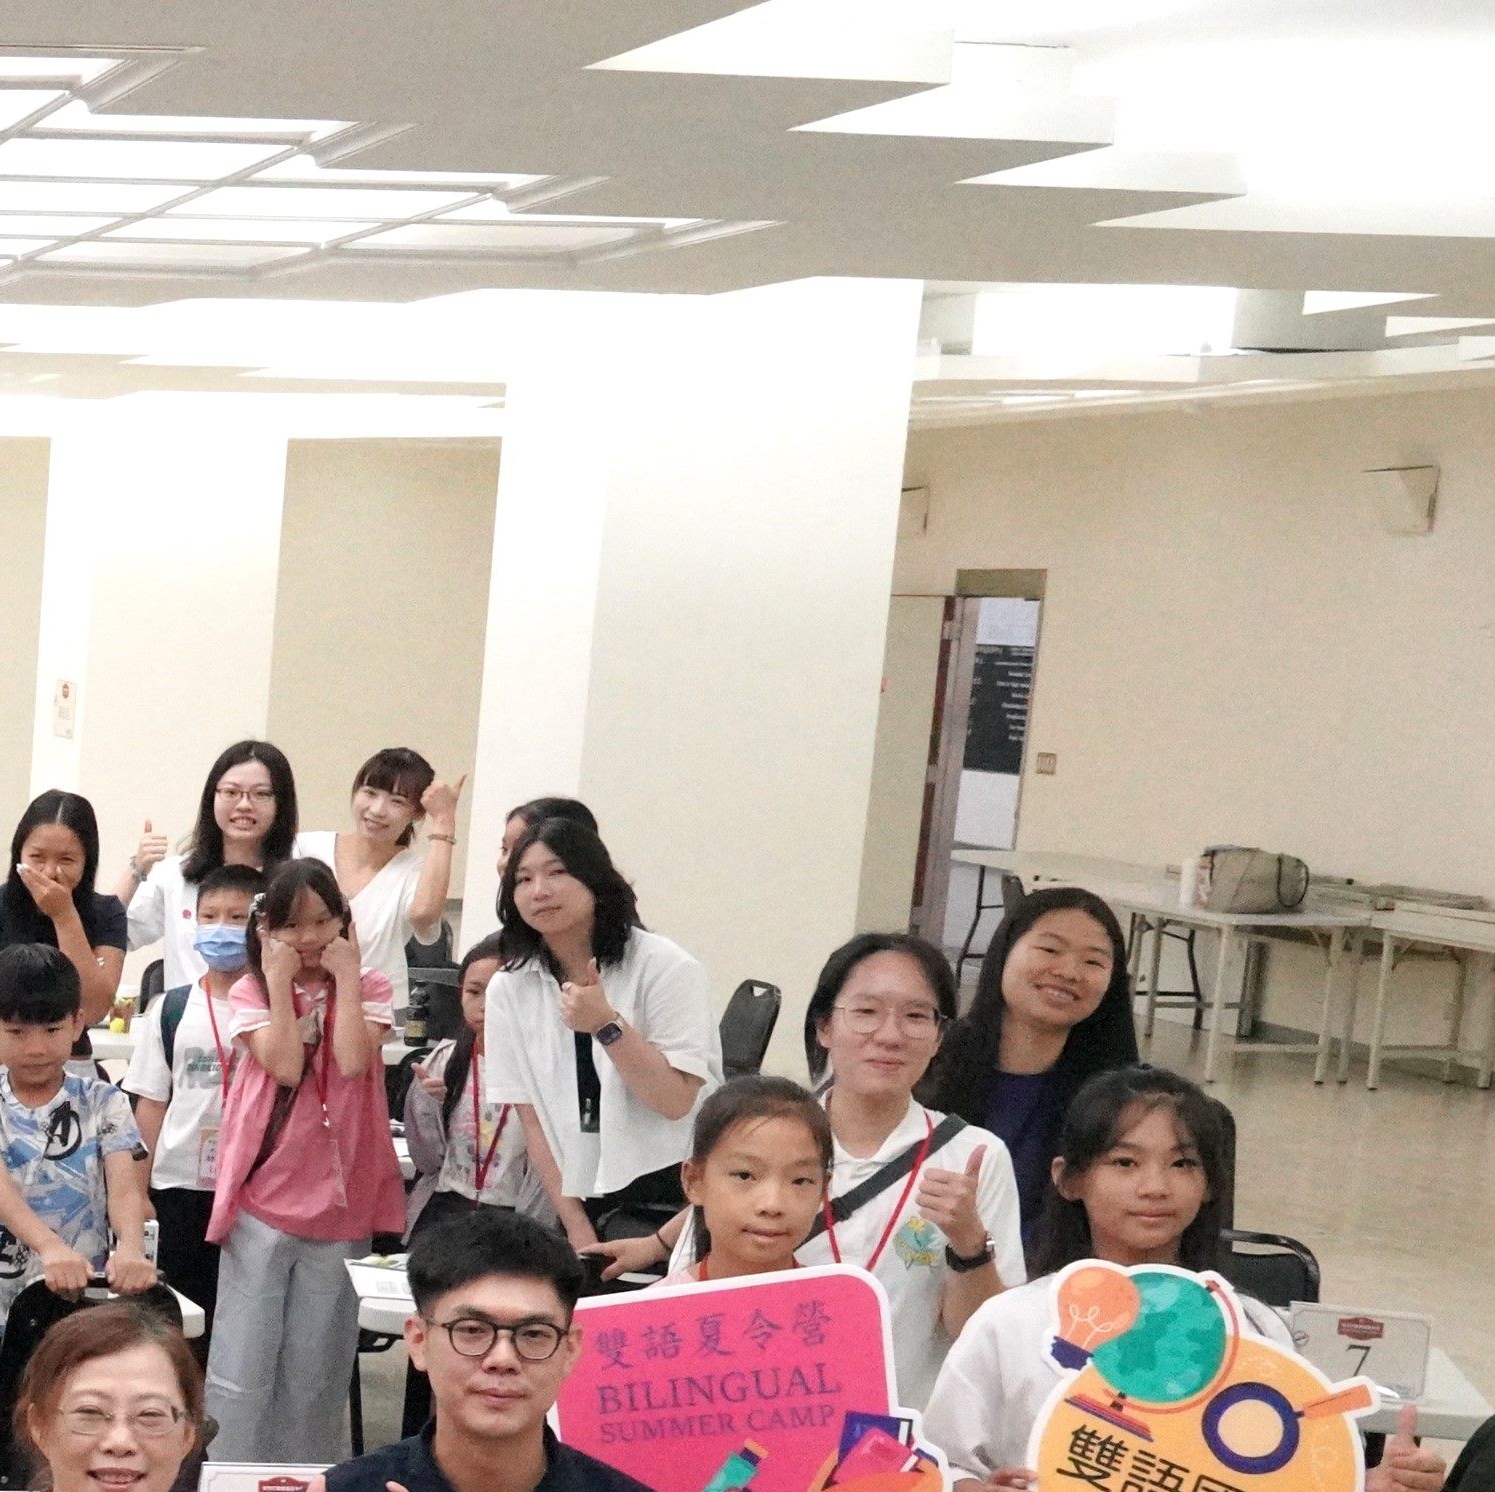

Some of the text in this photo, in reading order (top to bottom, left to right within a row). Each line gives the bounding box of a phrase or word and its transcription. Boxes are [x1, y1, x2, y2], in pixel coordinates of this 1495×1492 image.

[595, 1299, 832, 1372] 雙語夏令營
[596, 1361, 842, 1416] BILINGUAL
[599, 1403, 836, 1444] SUMMER CAMP
